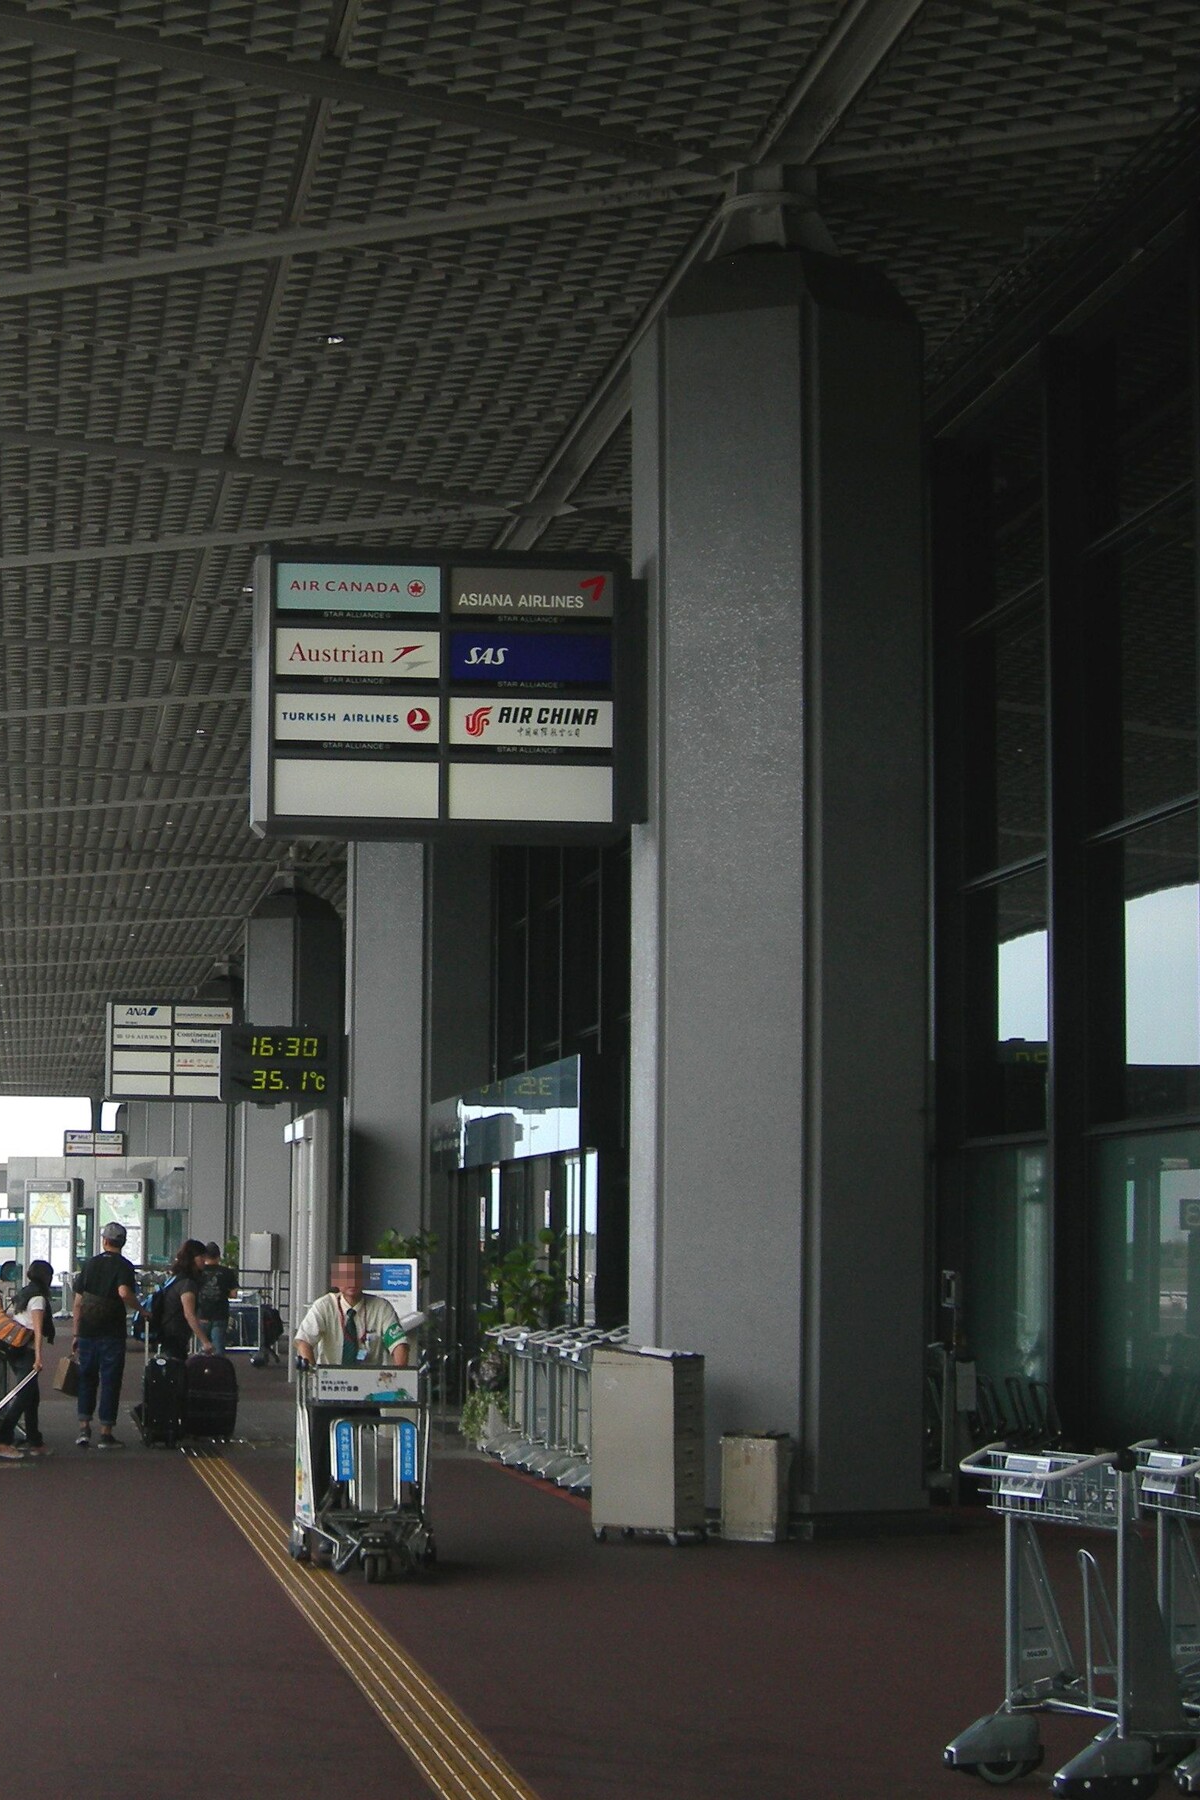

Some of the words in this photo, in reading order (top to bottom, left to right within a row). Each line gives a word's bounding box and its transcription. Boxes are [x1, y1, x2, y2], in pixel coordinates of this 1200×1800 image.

[290, 580, 320, 591] AIR
[325, 580, 400, 593] CANADA
[458, 593, 514, 607] ASIANA
[517, 594, 585, 609] AIRLINES
[520, 616, 558, 624] ALLIANCE
[289, 642, 385, 663] Austrian
[464, 647, 509, 665] SAS
[345, 677, 385, 685] ALLIANCE
[520, 681, 558, 689] ALLIANCE
[281, 712, 336, 722] TURKISH
[343, 713, 399, 723] AIRLINES
[498, 706, 534, 724] AIR
[537, 707, 599, 726] CHINA
[345, 742, 384, 750] ALLIANCE
[125, 1007, 147, 1016] ANA
[251, 1036, 318, 1057] 16:30
